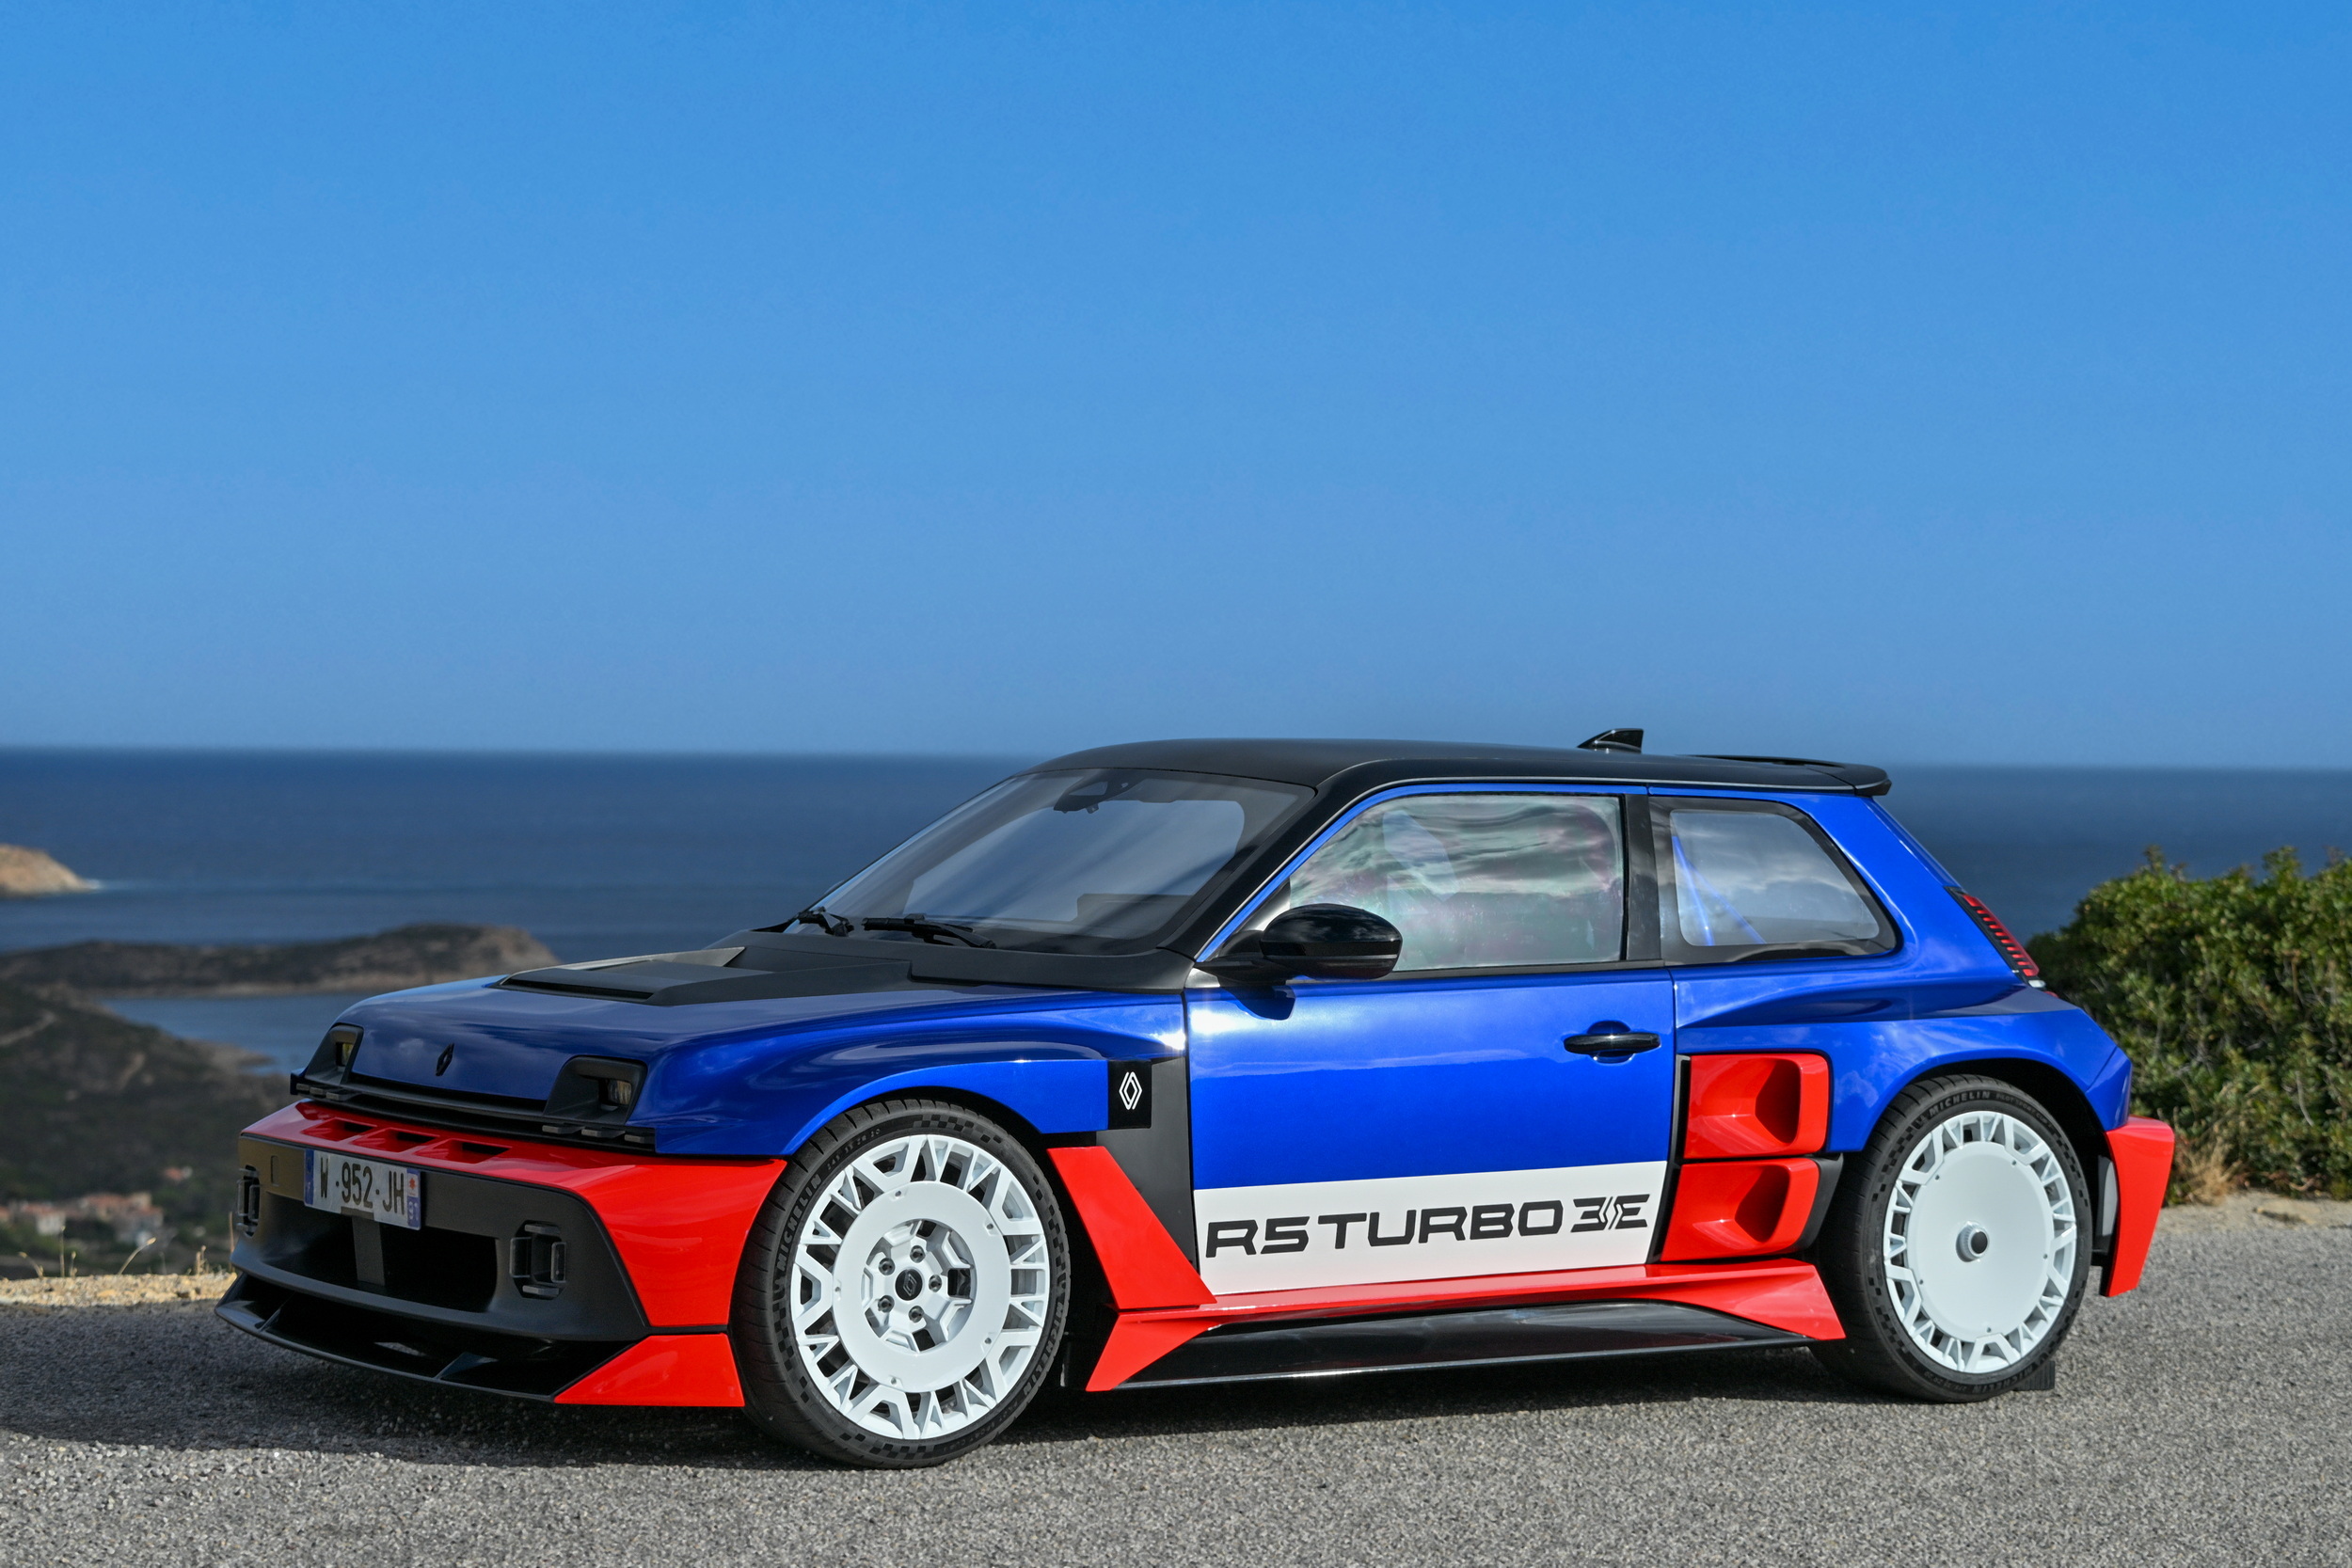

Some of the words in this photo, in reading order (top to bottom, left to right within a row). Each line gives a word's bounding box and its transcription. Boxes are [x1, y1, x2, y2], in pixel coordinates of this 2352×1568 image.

[1930, 1091, 1990, 1117] MICHELIN
[776, 1173, 822, 1272] MICHELIN
[1023, 1302, 1064, 1396] MICHELIN
